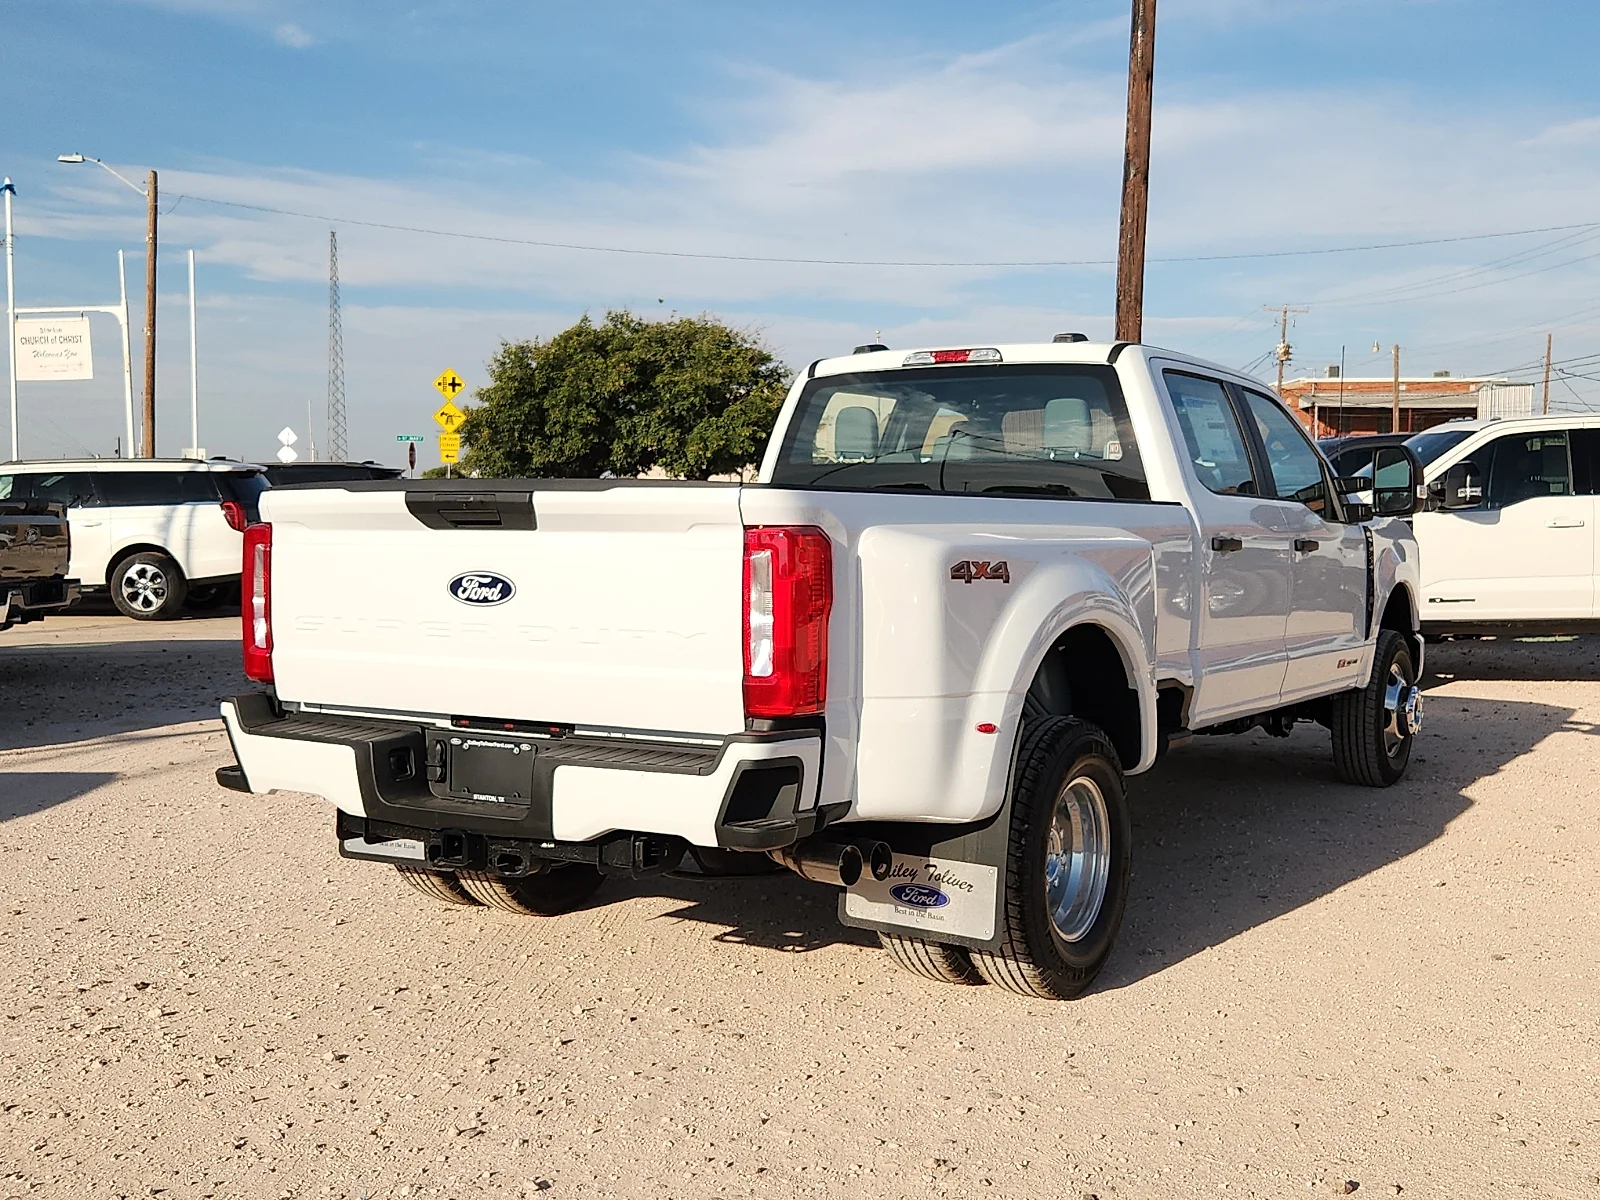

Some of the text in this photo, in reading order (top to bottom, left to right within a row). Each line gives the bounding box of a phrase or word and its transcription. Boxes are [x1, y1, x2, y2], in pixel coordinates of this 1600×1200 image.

[20, 334, 83, 345] CHURCH of CHRIST
[457, 575, 503, 601] Ford
[294, 615, 707, 652] SUPER DUTY
[924, 863, 974, 893] Toliver
[901, 886, 939, 906] Ford
[894, 906, 945, 922] Best in the Basin
